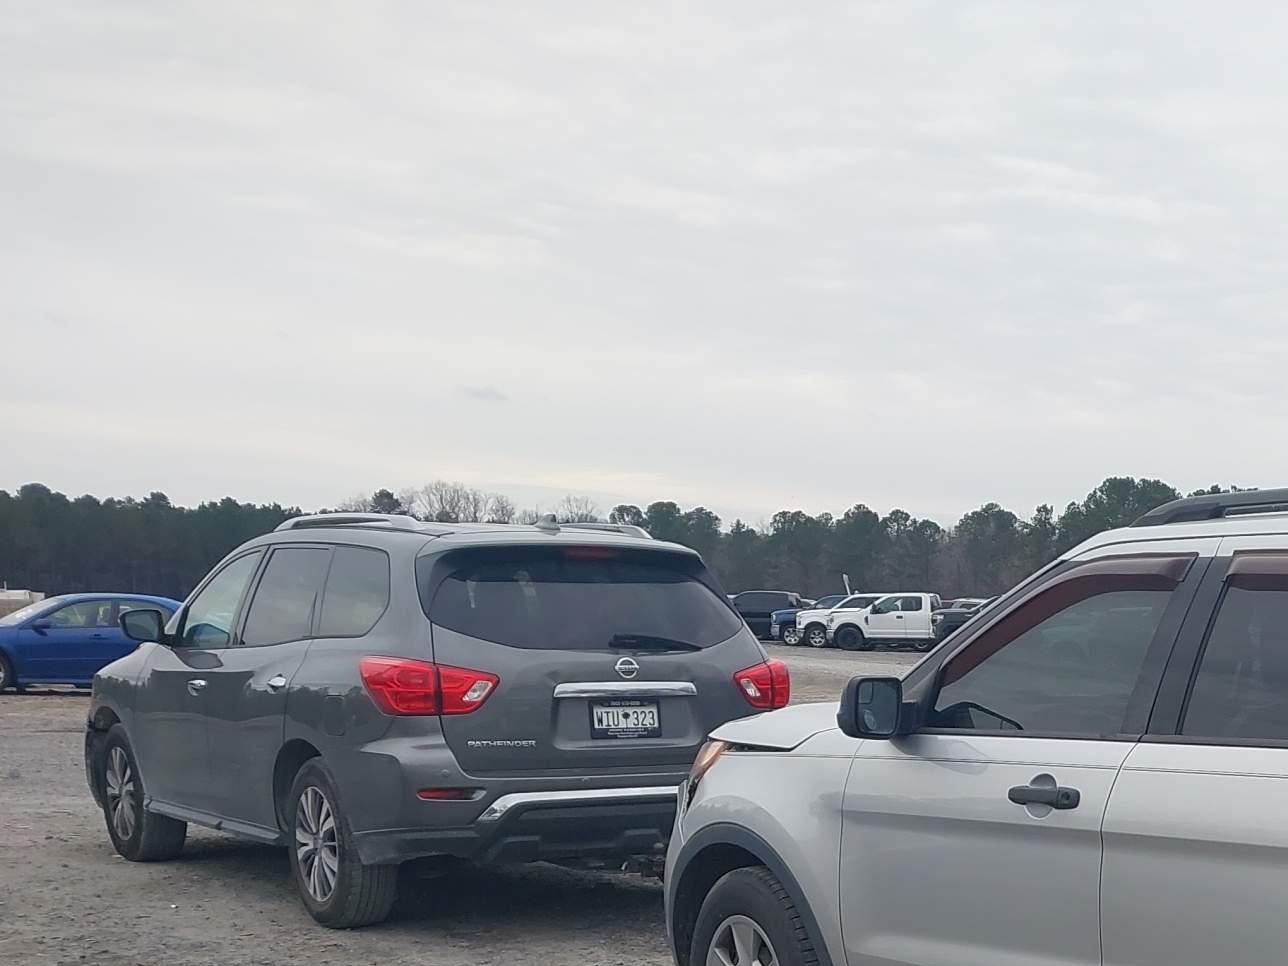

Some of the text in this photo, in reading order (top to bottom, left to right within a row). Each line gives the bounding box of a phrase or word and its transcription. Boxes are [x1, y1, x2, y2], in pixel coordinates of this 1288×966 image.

[596, 710, 656, 728] WIU 323
[467, 740, 537, 748] PATHFINDER
